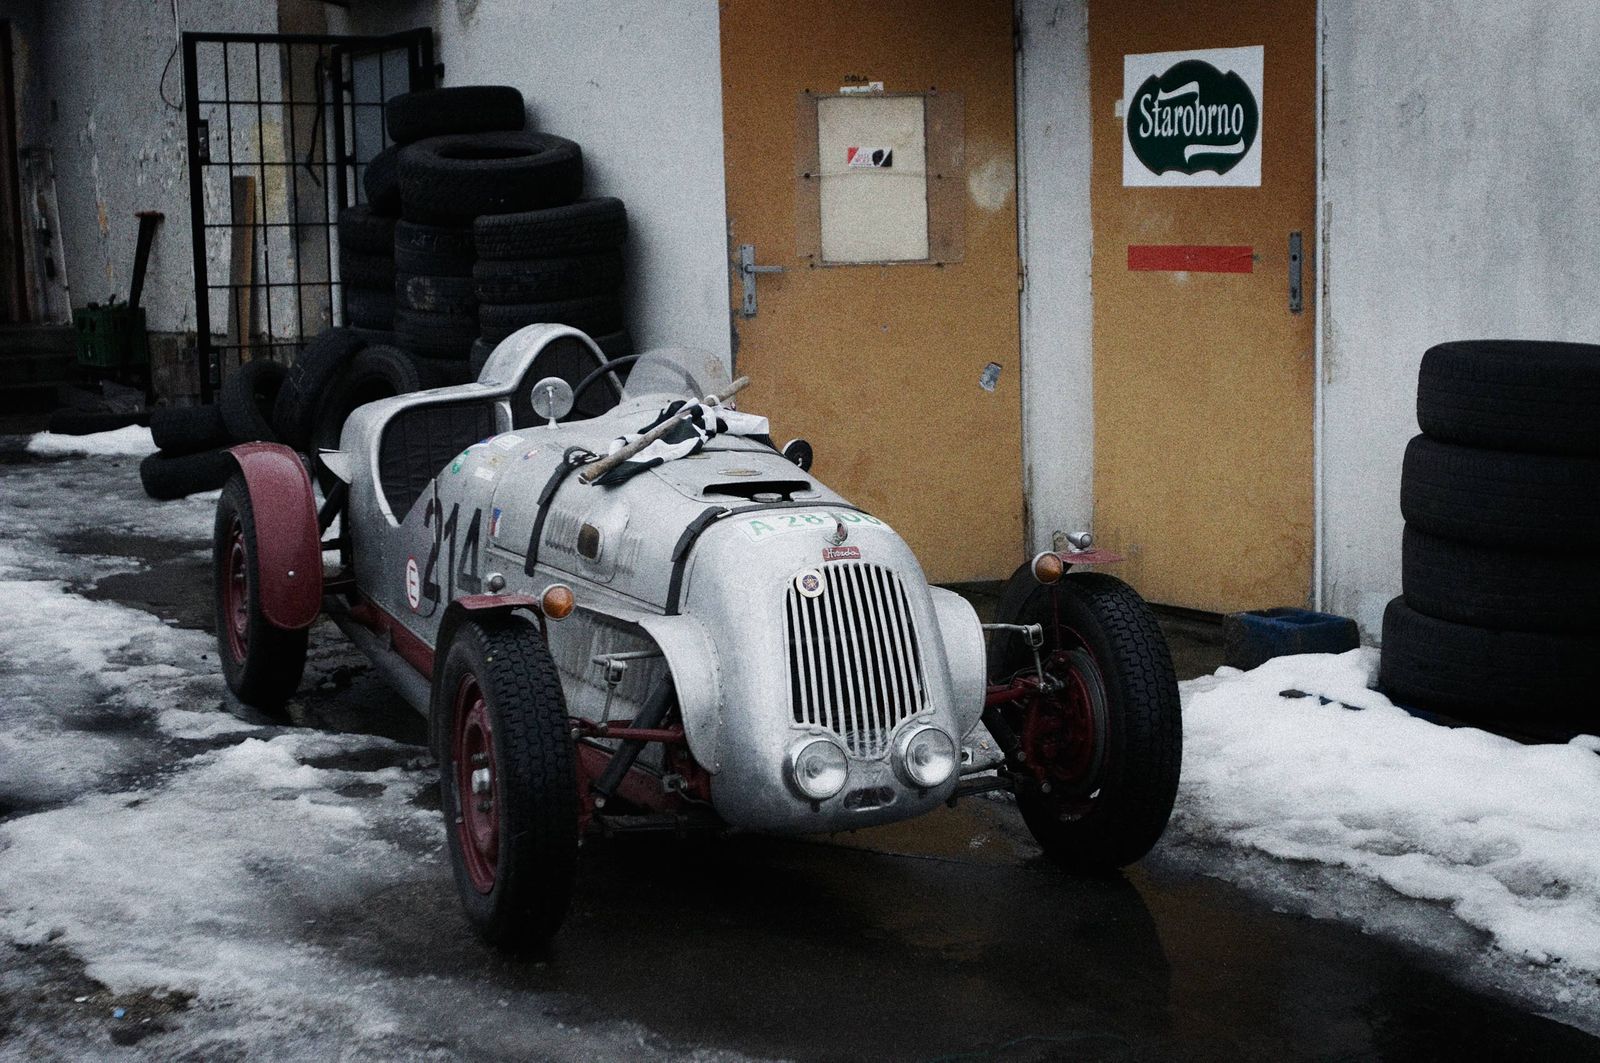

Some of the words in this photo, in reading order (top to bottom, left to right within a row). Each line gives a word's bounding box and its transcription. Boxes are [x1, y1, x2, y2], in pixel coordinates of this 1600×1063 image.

[1139, 81, 1244, 138] Starobrno
[423, 497, 482, 603] 214
[750, 520, 775, 536] A
